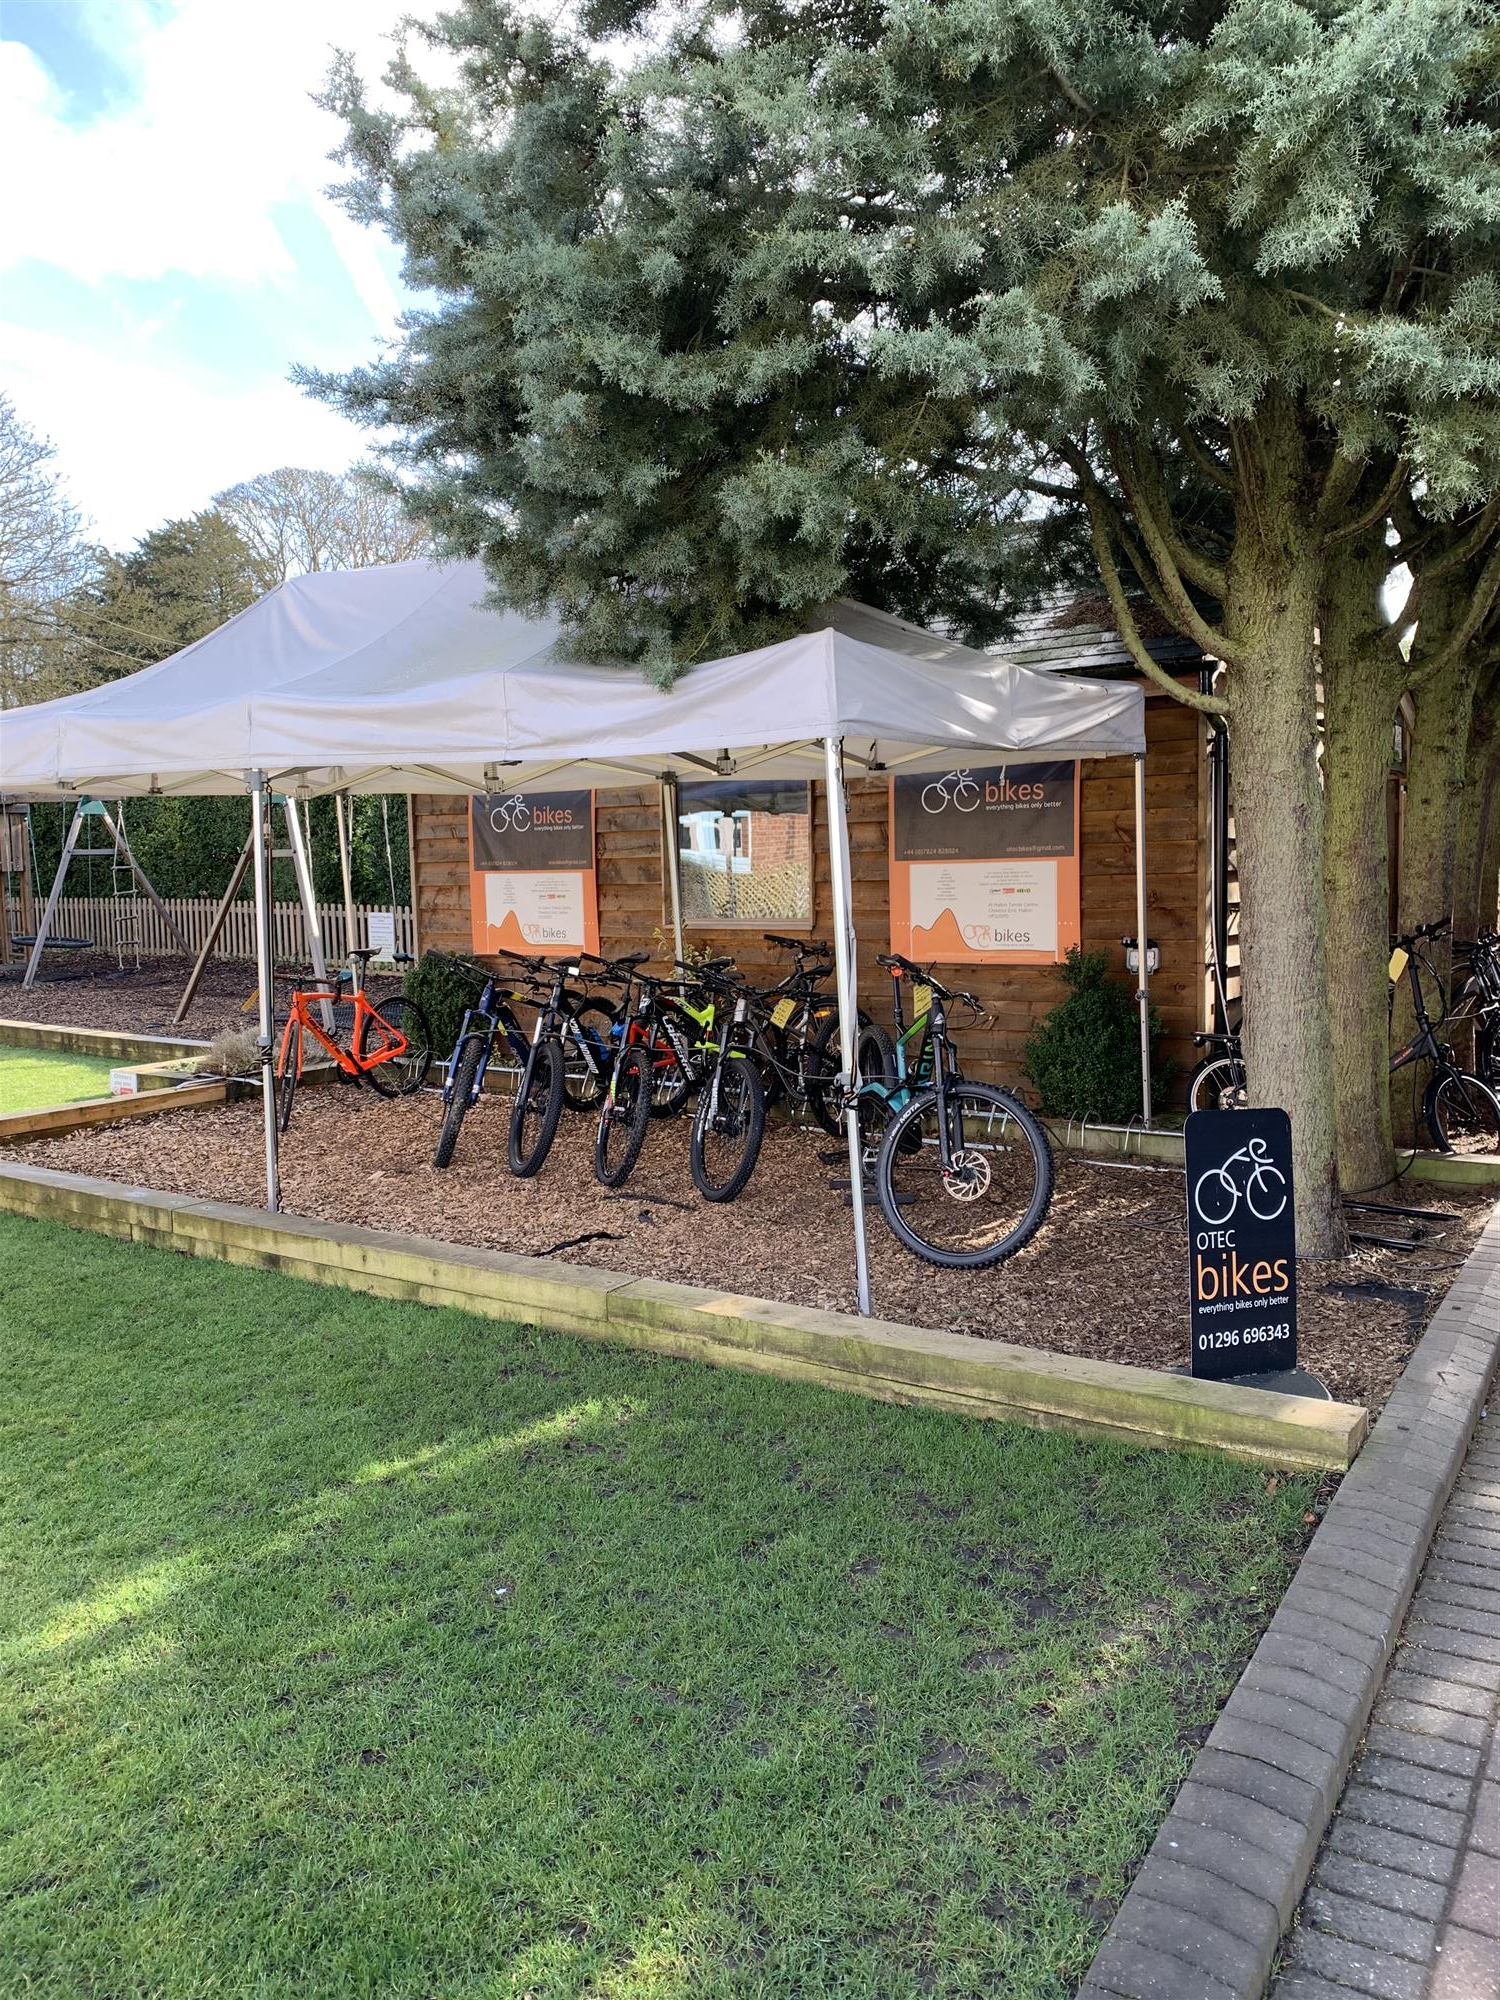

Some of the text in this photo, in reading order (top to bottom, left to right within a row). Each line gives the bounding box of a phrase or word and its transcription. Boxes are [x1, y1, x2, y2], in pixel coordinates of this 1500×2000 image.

[985, 779, 1044, 802] bikes
[533, 806, 573, 825] bikes
[985, 803, 1015, 811] everything
[1030, 801, 1043, 809] only
[542, 928, 567, 939] bikes
[994, 928, 1031, 943] bikes
[662, 1015, 697, 1081] LAPIERRE
[1196, 1230, 1236, 1250] OTEC
[1197, 1251, 1289, 1300] bikes
[1198, 1296, 1289, 1315] everything bikes only better
[1199, 1323, 1290, 1350] 01296 696343
